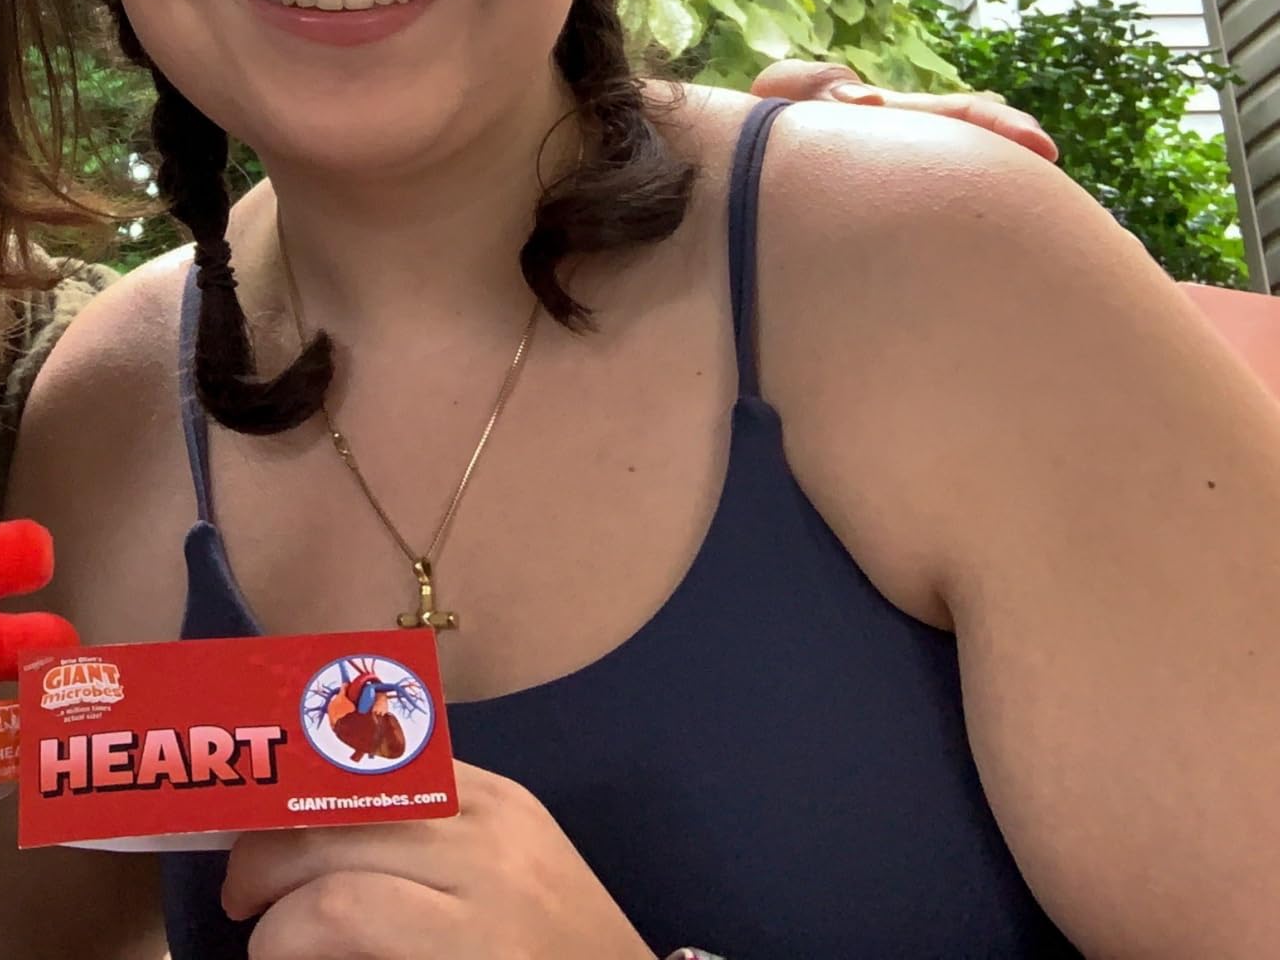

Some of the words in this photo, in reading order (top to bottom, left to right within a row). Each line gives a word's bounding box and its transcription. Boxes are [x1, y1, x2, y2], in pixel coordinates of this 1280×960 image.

[43, 664, 119, 692] GIANT
[43, 687, 123, 705] microbes
[39, 726, 284, 796] HEART
[287, 792, 448, 812] GIANTmicrobes.com
